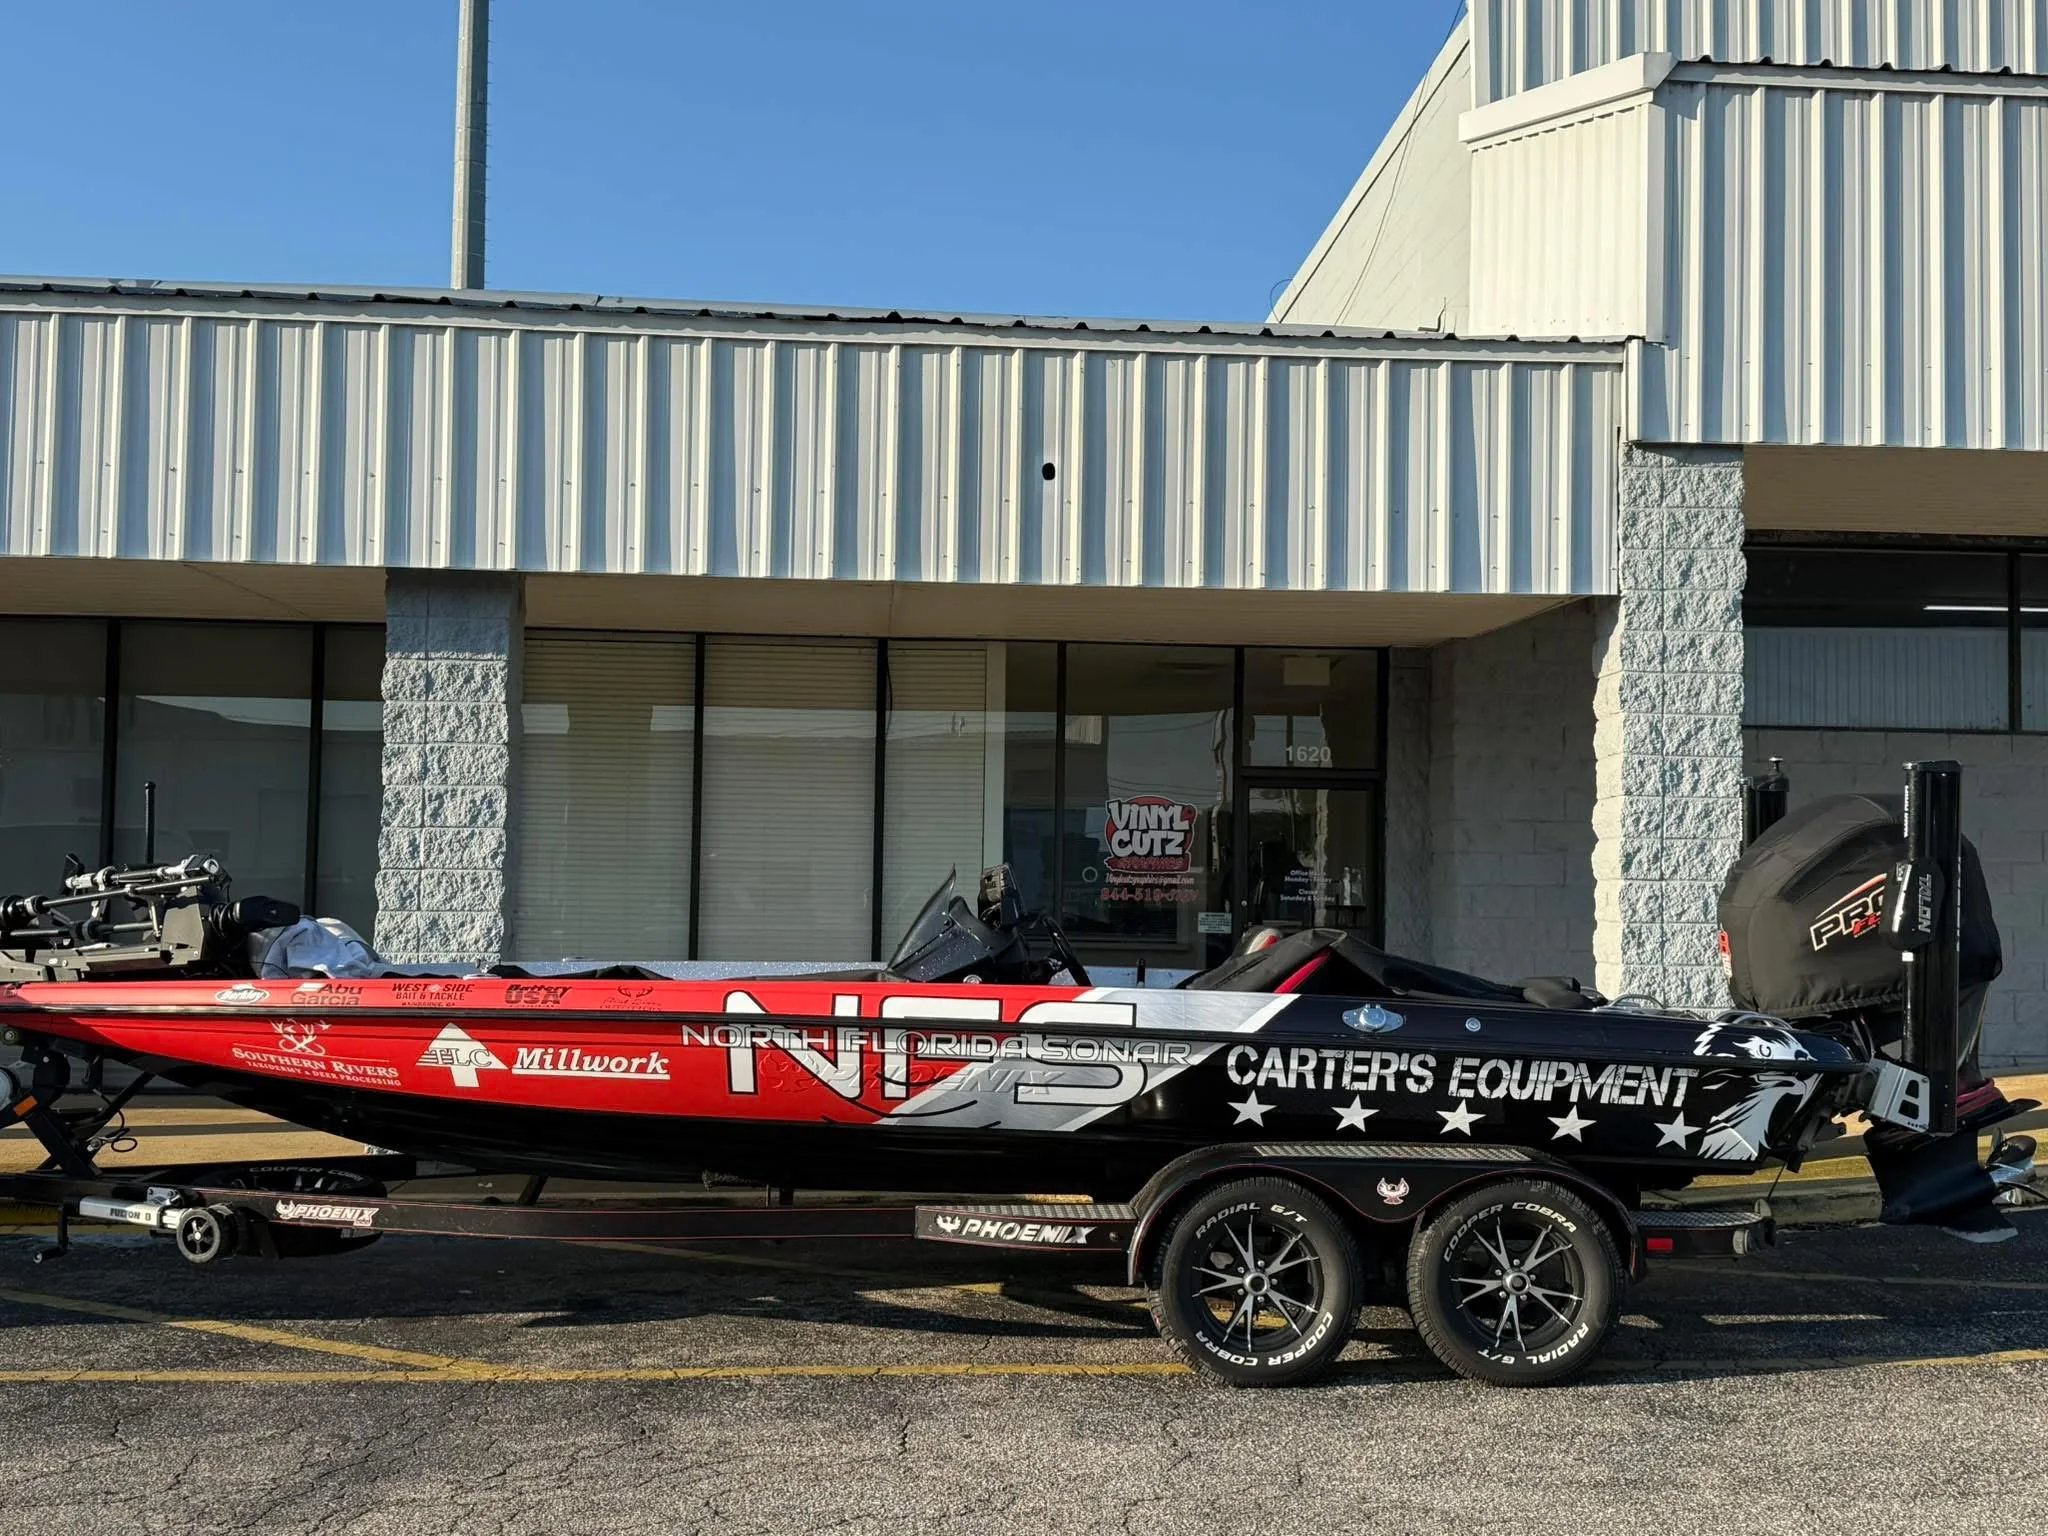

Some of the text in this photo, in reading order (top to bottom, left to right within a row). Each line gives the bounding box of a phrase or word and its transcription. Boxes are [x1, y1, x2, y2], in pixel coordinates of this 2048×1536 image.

[1286, 746, 1331, 762] 1620
[1107, 801, 1190, 830] VINYL
[1111, 829, 1184, 857] CUTZ
[1919, 874, 1932, 933] TALON
[220, 989, 265, 1001] Berkley
[290, 991, 360, 1006] Garcia
[318, 983, 363, 995] Abu
[392, 983, 475, 992] WEST SIDE
[395, 992, 465, 1000] BAIT & TACKLE
[505, 990, 561, 1004] USA
[506, 984, 573, 998] Battery
[428, 1047, 493, 1067] TLC
[681, 1023, 1193, 1066] NORTH FLORIDA SONAR
[231, 1047, 400, 1078] SOUTHERN RIVERS
[515, 1046, 670, 1074] Millwork
[247, 1061, 302, 1075] TAXIDERMY
[314, 1070, 338, 1079] DEER
[339, 1074, 402, 1087] PROCESSING
[1226, 1044, 1701, 1108] CARTER'S EQUIPMENT
[249, 1166, 324, 1174] COOPER
[294, 1203, 379, 1221] PHOENIX
[1195, 1201, 1308, 1240] RADIAL G/T
[961, 1217, 1098, 1245] PHOENIX
[1443, 1201, 1579, 1263] COOPER COBRA
[1195, 1311, 1334, 1367] COOPER COBRA
[1477, 1322, 1590, 1365] RADIAL G/T
